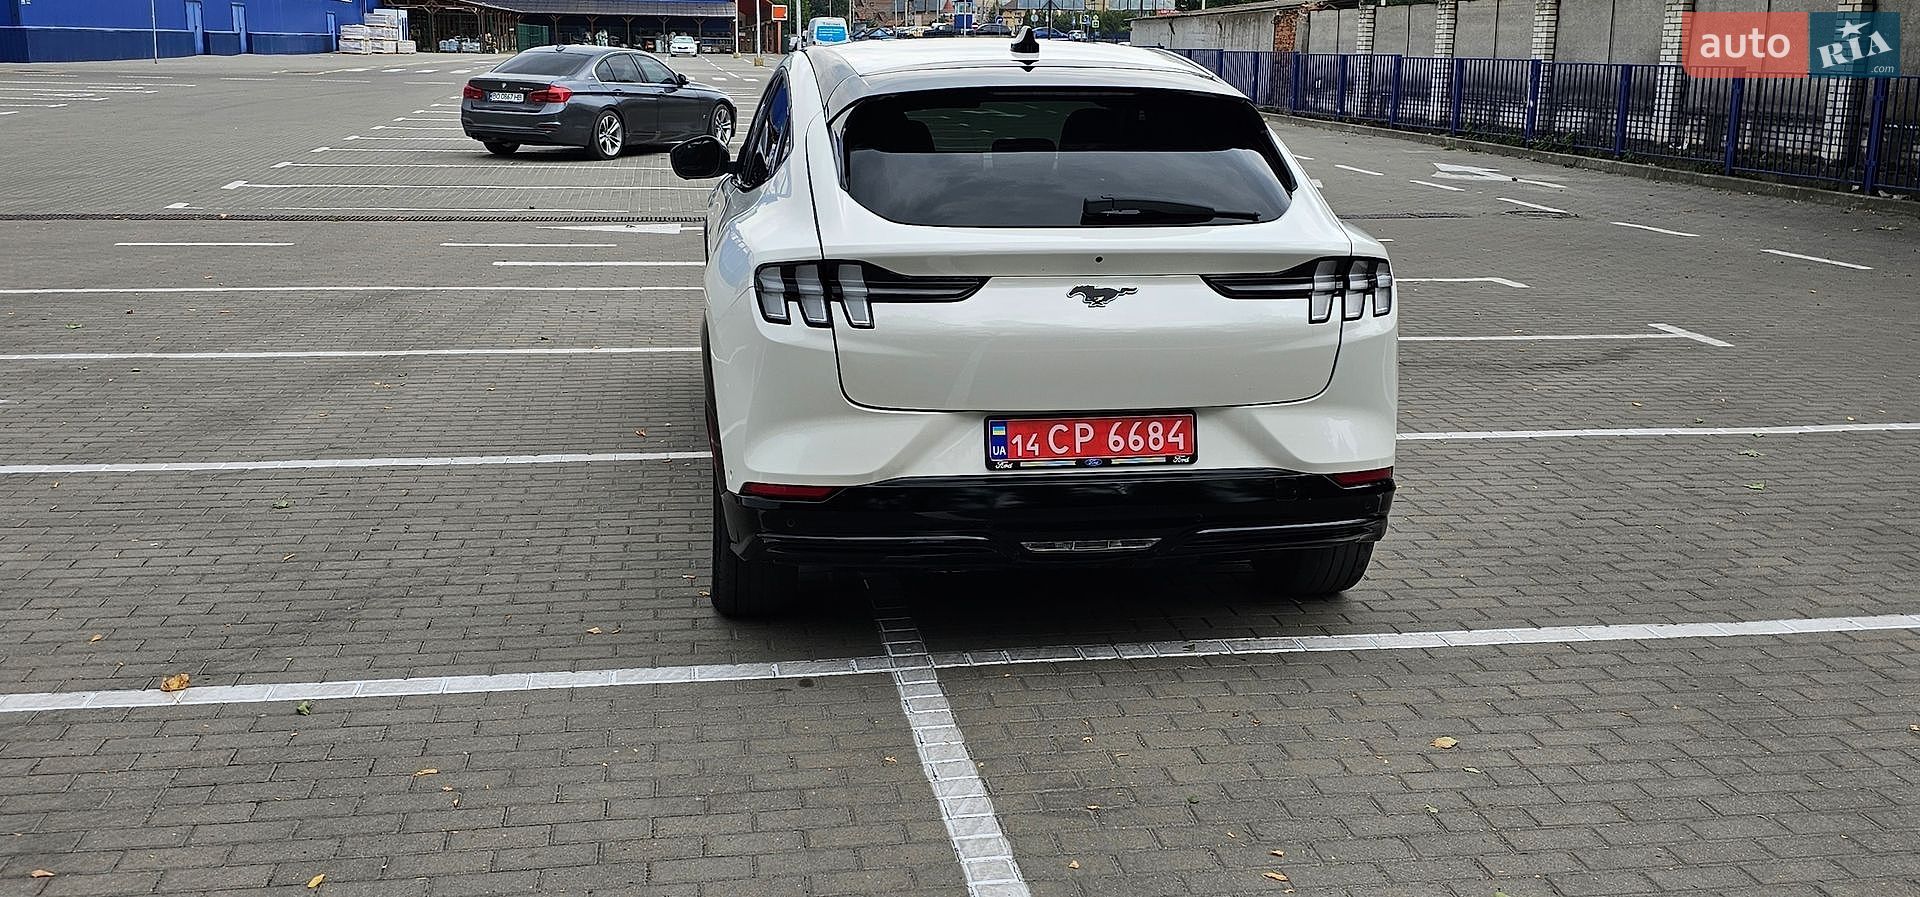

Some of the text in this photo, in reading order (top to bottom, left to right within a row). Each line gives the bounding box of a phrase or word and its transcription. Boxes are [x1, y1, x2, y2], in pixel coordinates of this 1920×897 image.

[1011, 420, 1185, 456] 14 CP 6684
[992, 446, 1006, 456] UA
[995, 461, 1014, 469] Ford
